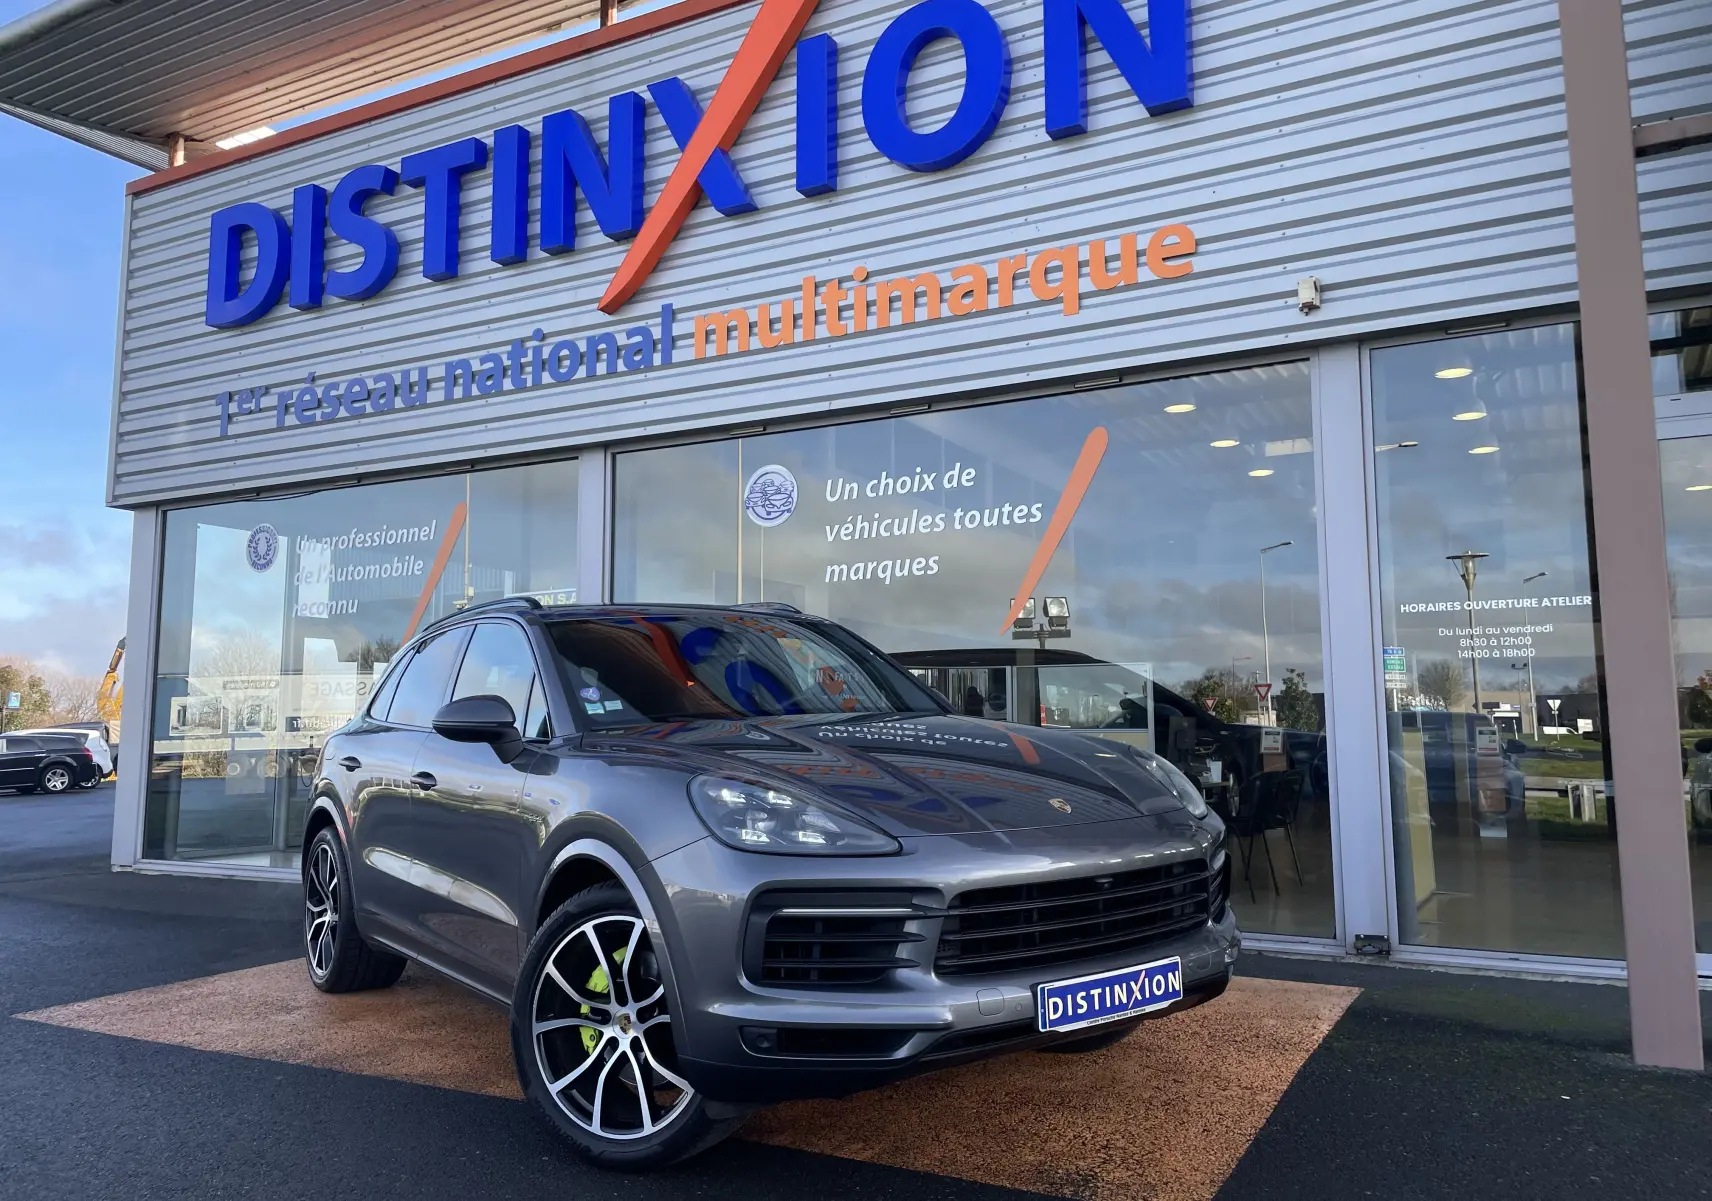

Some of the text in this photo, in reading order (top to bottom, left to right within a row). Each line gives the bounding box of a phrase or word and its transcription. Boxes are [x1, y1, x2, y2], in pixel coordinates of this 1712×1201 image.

[204, 0, 1194, 328] DISTINXION
[215, 222, 1197, 437] 1er réseau national multimarque
[826, 462, 976, 501] Un choix de
[295, 519, 437, 557] Un professionnel
[825, 502, 1043, 543] véhicules toutes
[293, 555, 424, 586] de l'Automobile
[825, 554, 940, 585] marques
[292, 599, 359, 618] reconnu
[1400, 595, 1592, 613] HORAIRES OUVERTURE ATELIER
[1438, 624, 1553, 636] Du lundi au vendredi
[1459, 636, 1532, 647] 8h30 à 12h00
[1457, 647, 1535, 659] 14h00 à 18h00
[1049, 970, 1180, 1020] DISTINXION
